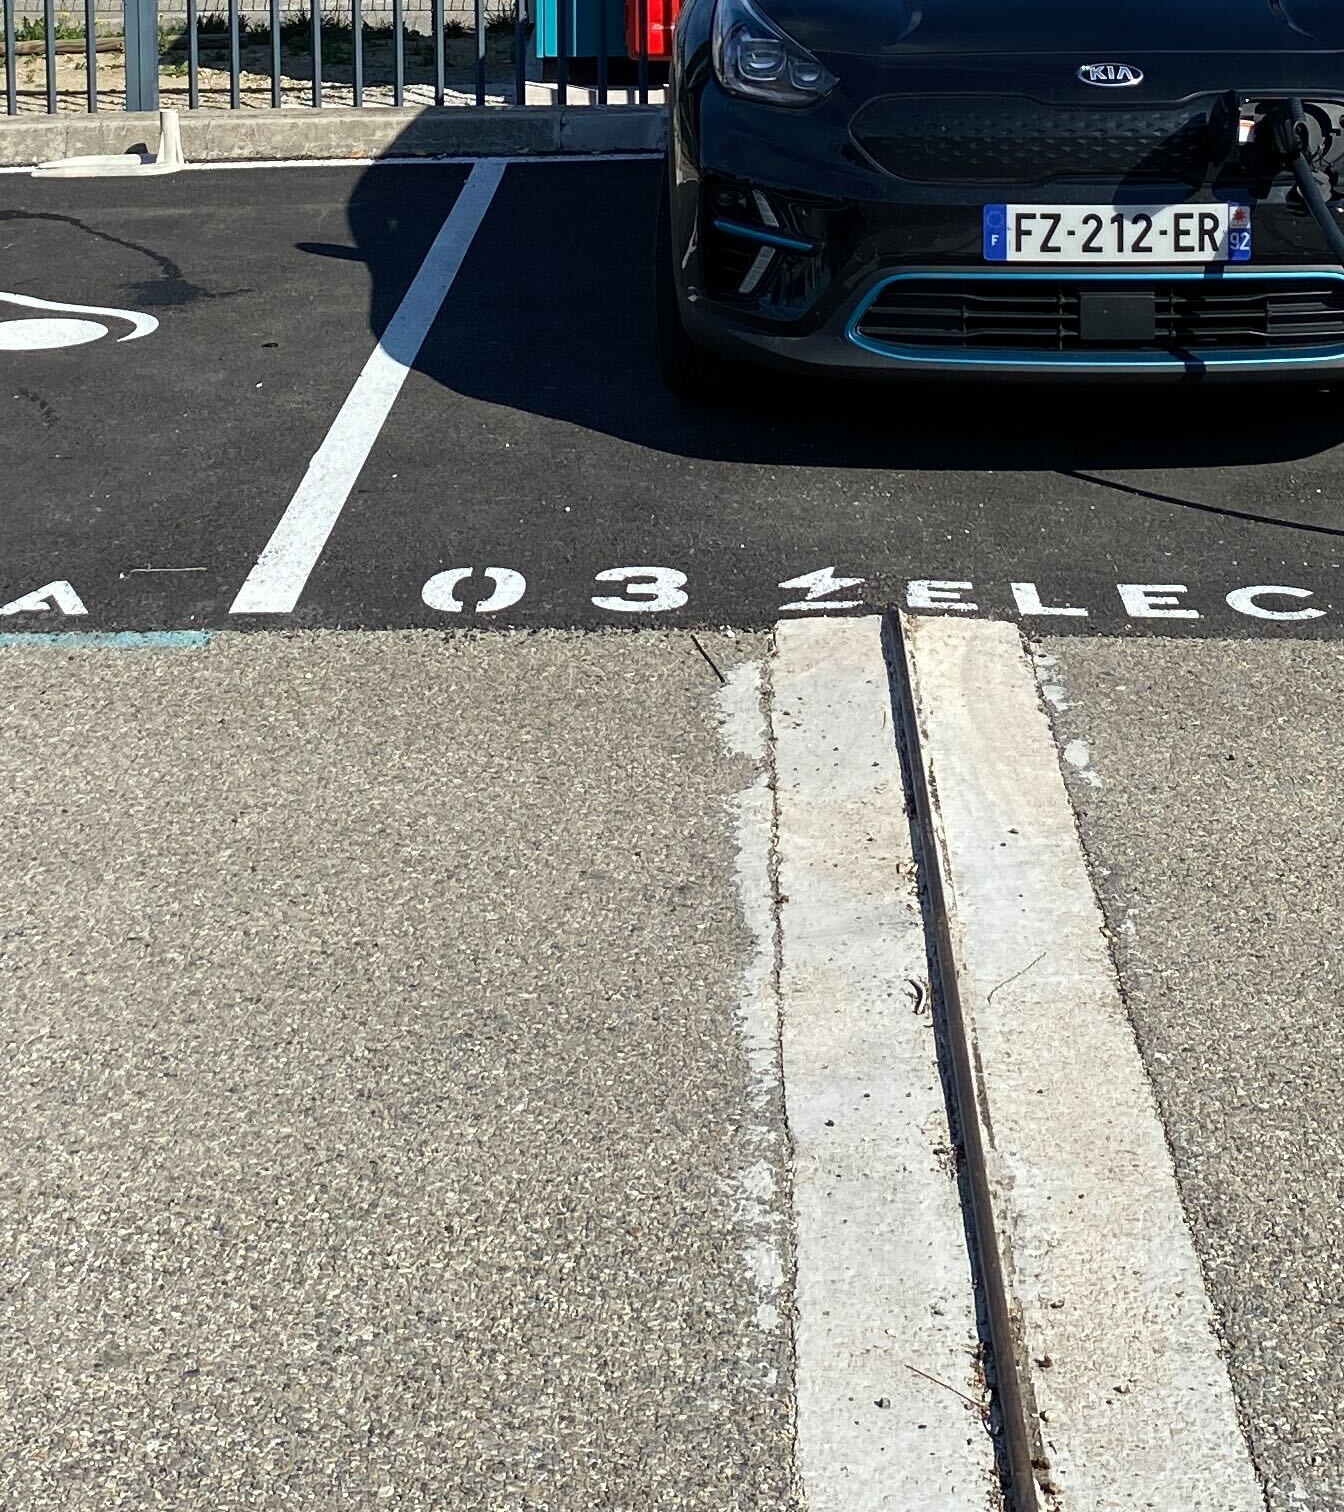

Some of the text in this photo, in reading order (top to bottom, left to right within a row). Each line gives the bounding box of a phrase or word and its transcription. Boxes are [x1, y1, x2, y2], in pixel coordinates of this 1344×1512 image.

[1089, 66, 1134, 80] KIA
[990, 234, 1000, 247] F
[1014, 212, 1220, 253] FZ-212-ER
[1229, 231, 1251, 251] 92
